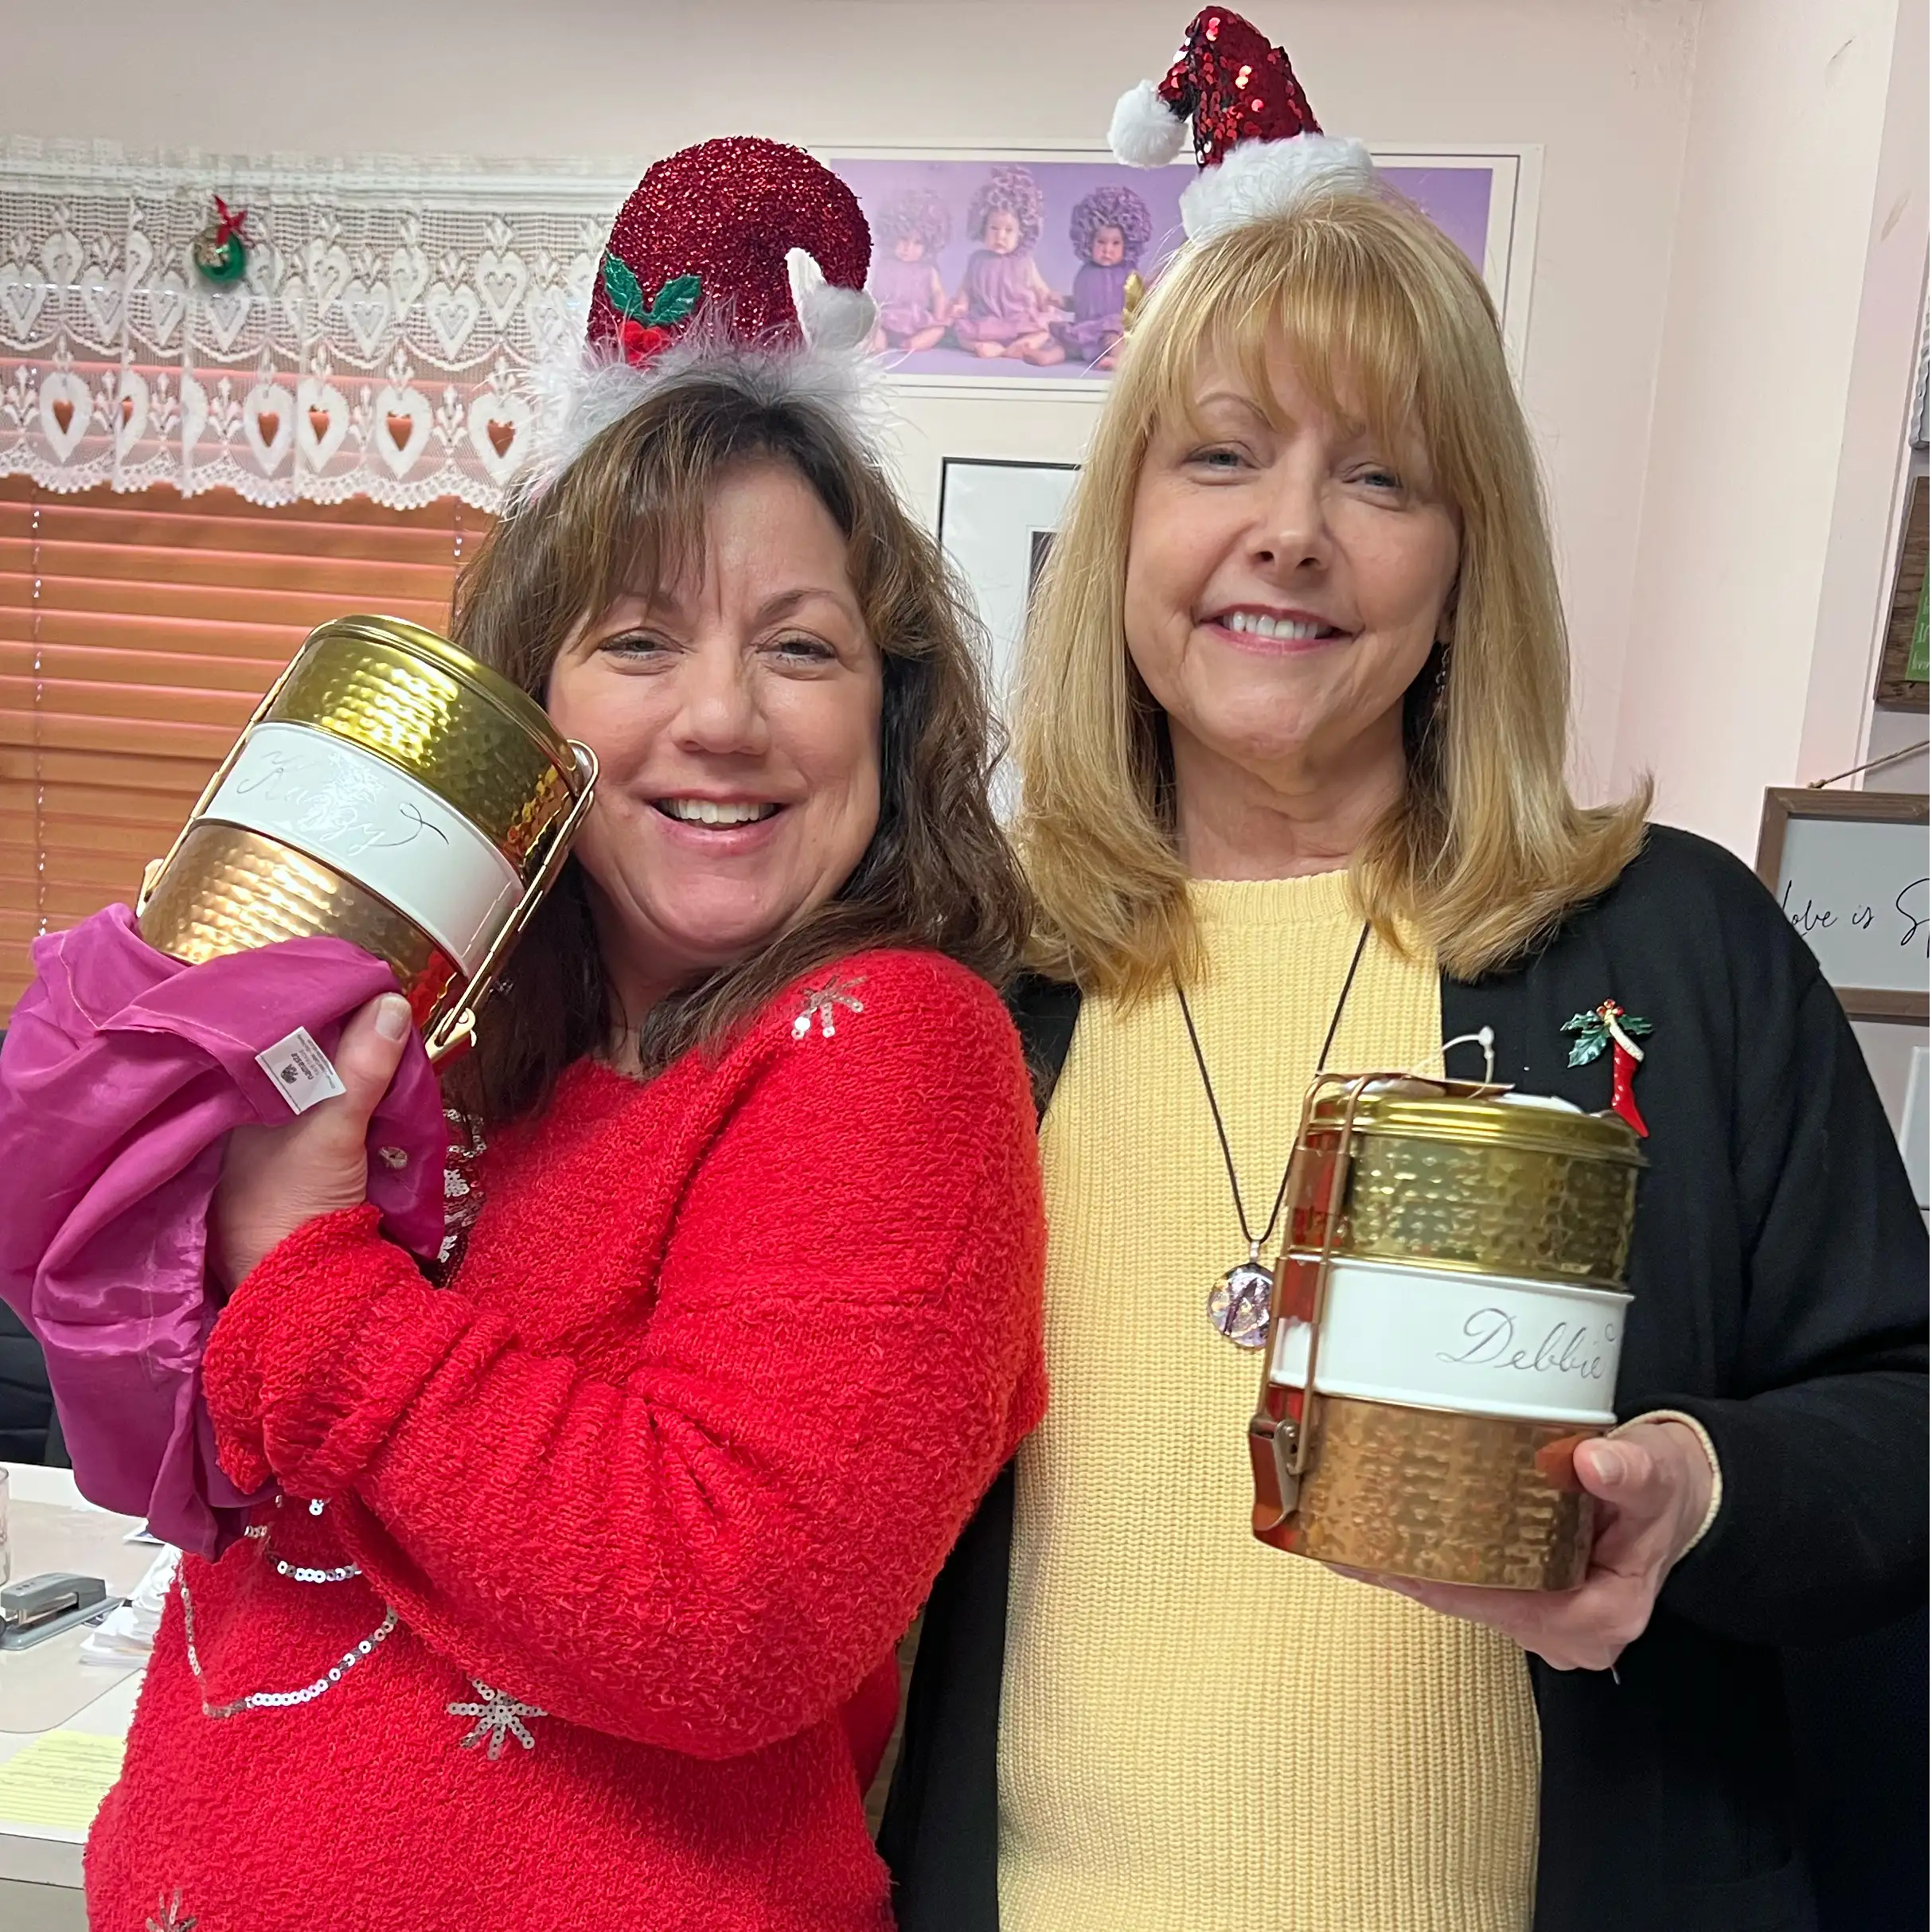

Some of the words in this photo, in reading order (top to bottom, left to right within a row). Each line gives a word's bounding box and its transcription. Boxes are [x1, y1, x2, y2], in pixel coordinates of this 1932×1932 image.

[1852, 904, 1875, 930] is
[1895, 877, 1930, 958] S
[1435, 1307, 1616, 1379] Debbie
